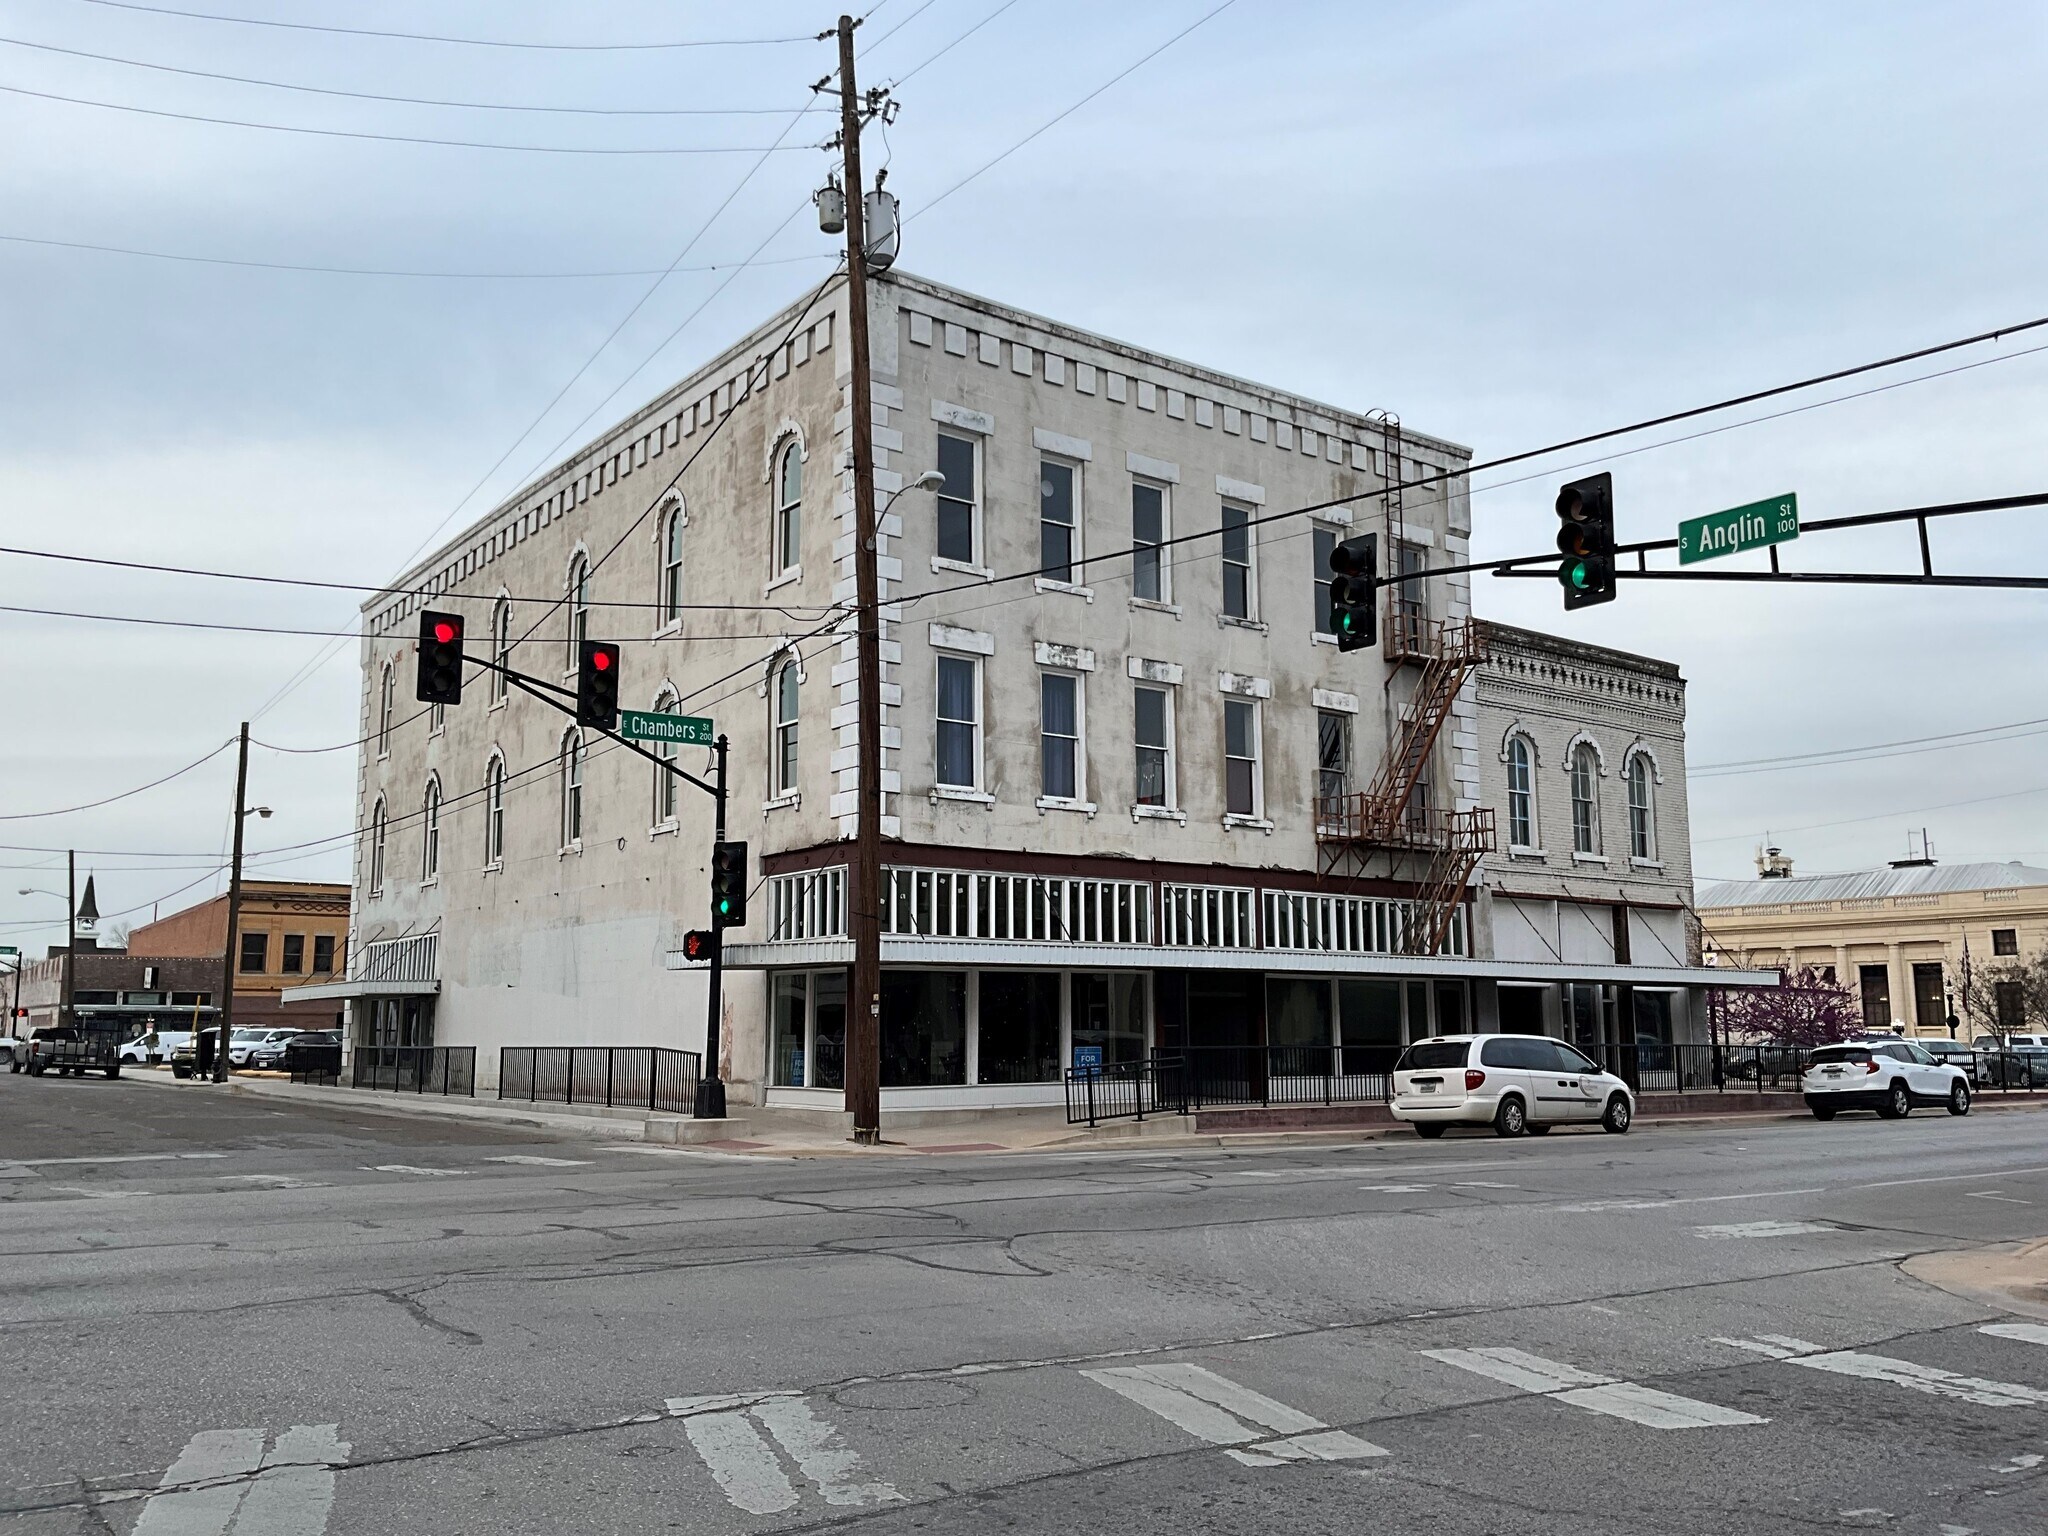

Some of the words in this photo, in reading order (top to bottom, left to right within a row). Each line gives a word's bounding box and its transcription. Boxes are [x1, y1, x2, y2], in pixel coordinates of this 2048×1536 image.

[1681, 537, 1688, 550] S
[1699, 513, 1766, 554] Anglin
[1780, 504, 1791, 517] St
[1777, 518, 1796, 533] 100
[623, 720, 628, 728] E
[632, 716, 695, 739] Chambers
[702, 723, 710, 732] St
[700, 732, 712, 741] 200
